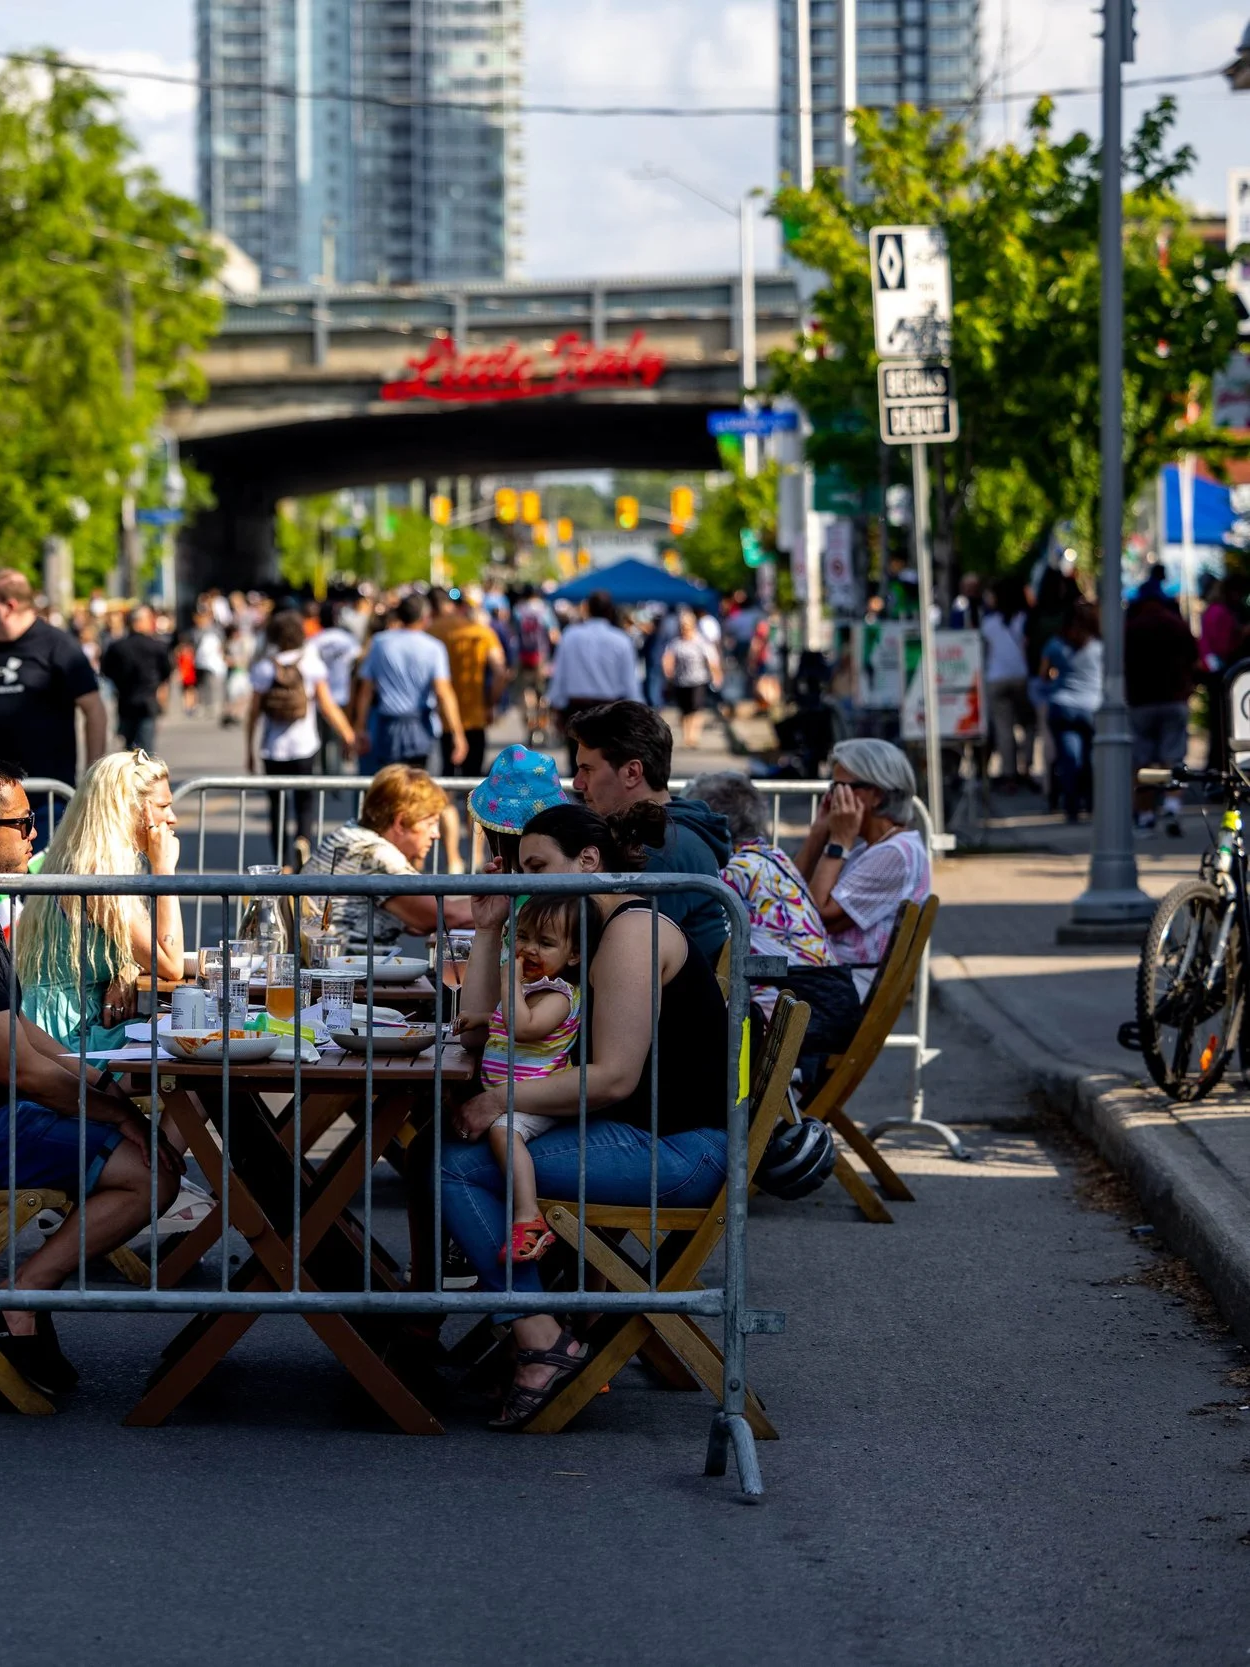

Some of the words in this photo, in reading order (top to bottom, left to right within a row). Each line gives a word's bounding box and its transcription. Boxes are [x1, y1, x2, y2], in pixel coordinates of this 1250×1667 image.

[398, 336, 536, 394] Little
[551, 331, 666, 389] Italy
[886, 369, 947, 396] BEGINS
